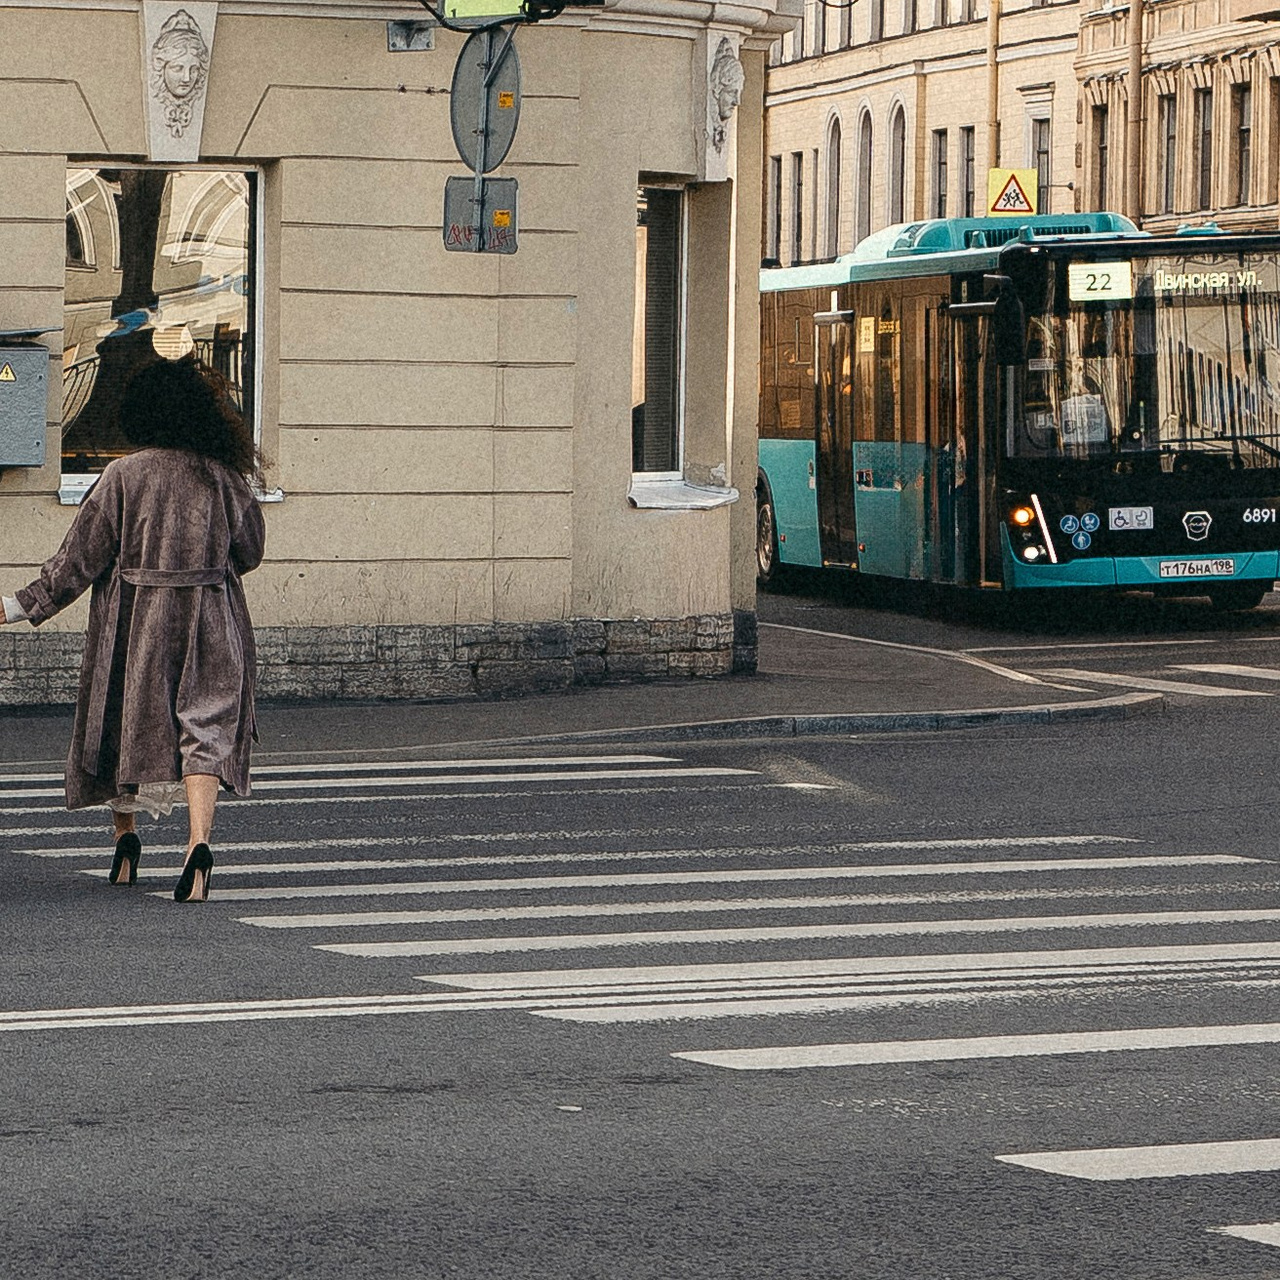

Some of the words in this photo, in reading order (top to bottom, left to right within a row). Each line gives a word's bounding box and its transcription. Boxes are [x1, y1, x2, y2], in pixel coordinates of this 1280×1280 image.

[1085, 273, 1112, 292] 22
[1154, 269, 1229, 290] Двинская
[1237, 270, 1263, 287] ул.
[1242, 507, 1277, 523] 6891
